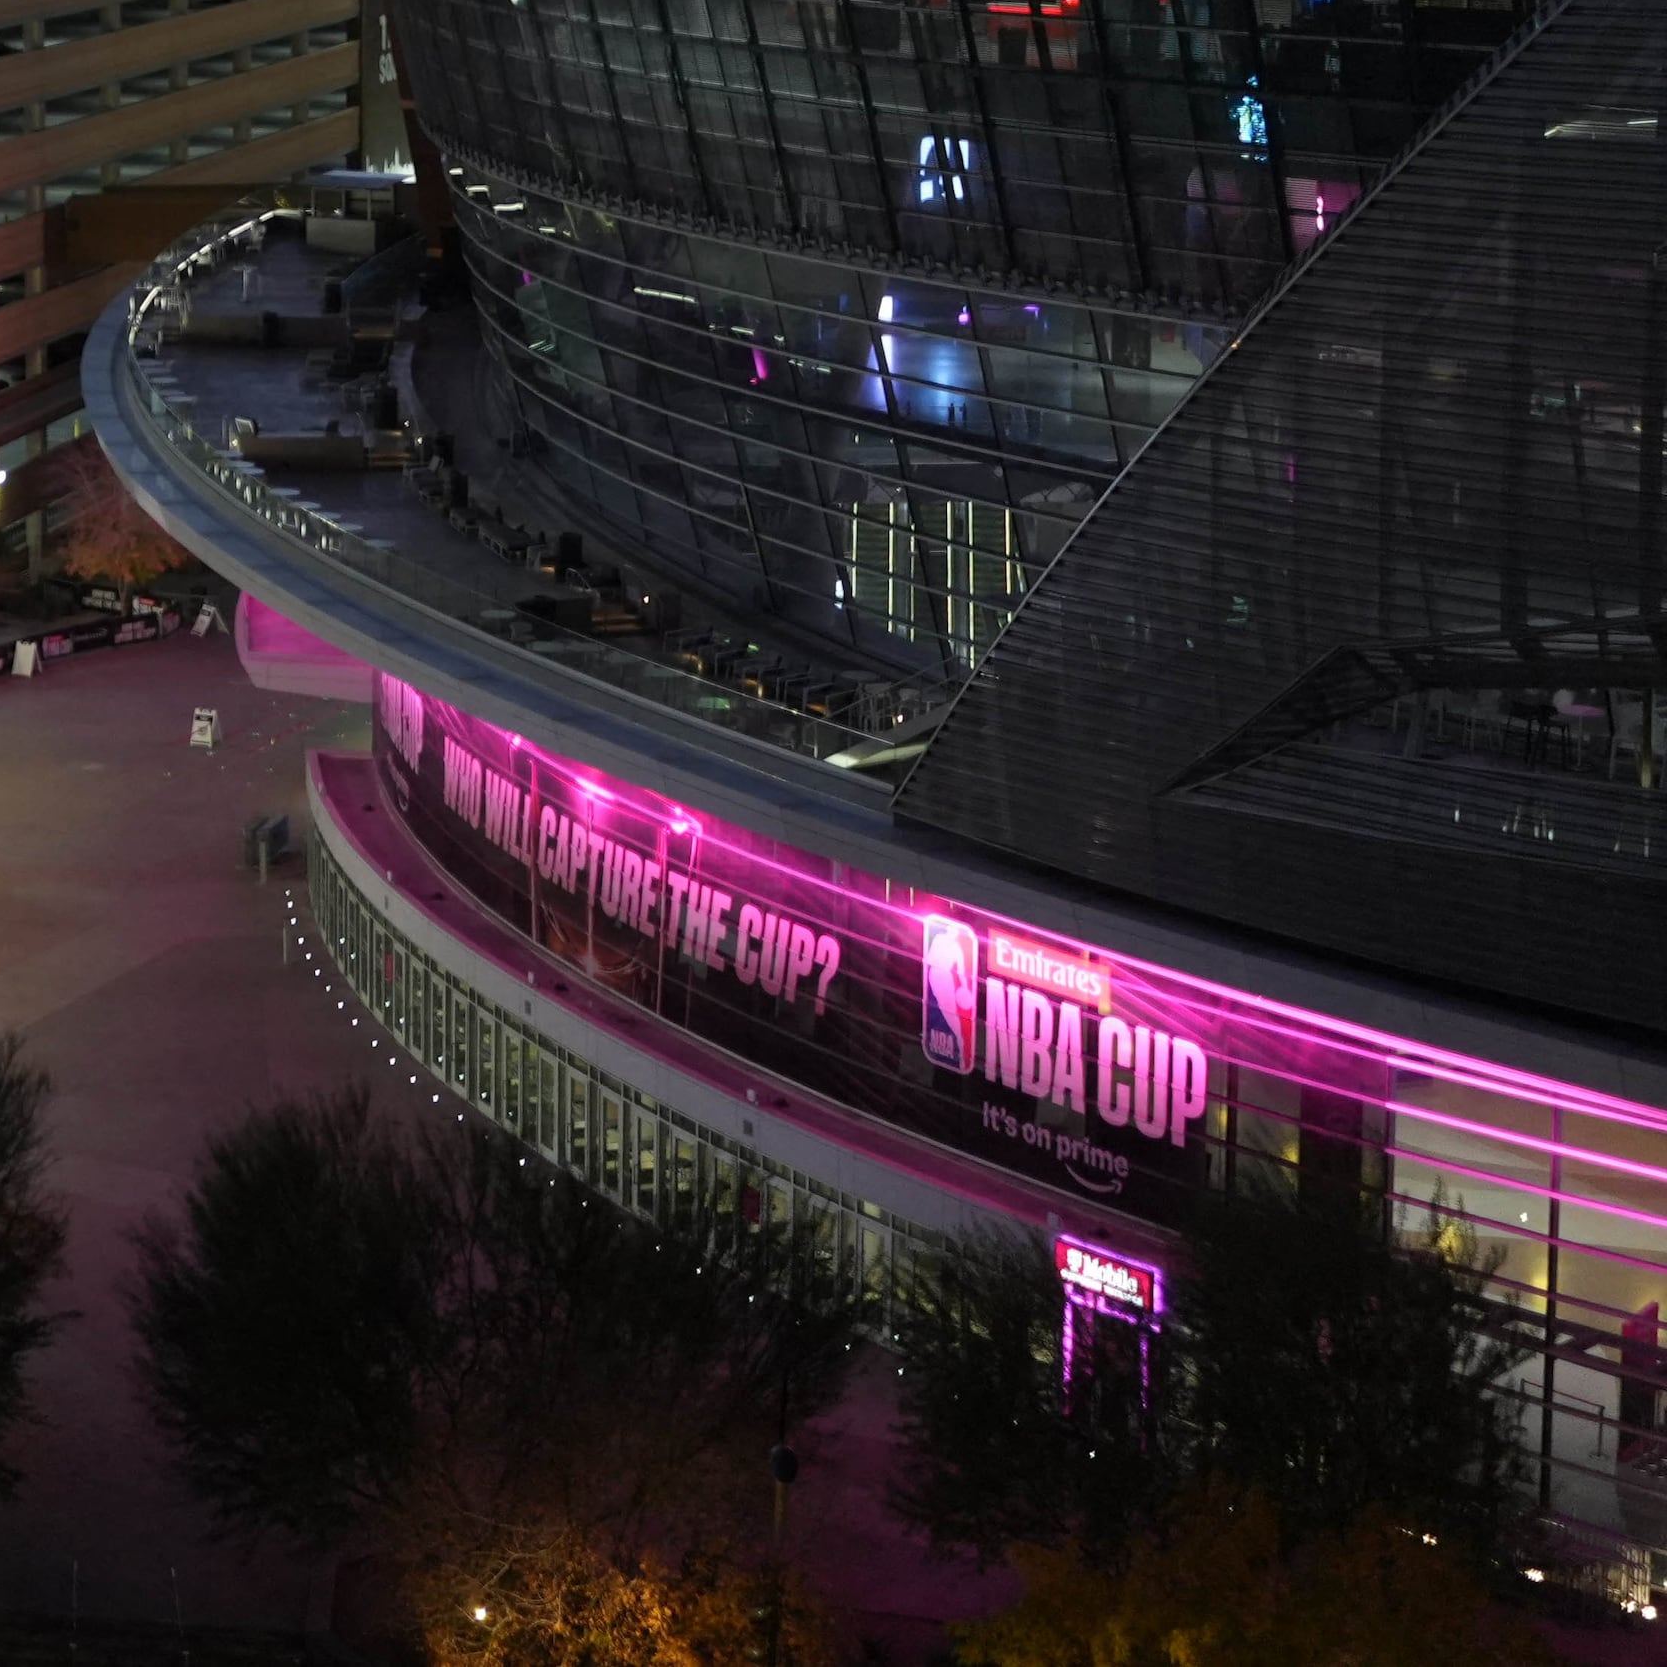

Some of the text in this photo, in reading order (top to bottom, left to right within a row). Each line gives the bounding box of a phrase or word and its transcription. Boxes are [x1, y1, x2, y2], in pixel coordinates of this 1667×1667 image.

[443, 734, 841, 1017] WHO WILL CAPTURE THE CUP?
[995, 936, 1103, 997] Emirates
[985, 977, 1208, 1149] NBA CUP
[982, 1100, 1130, 1178] It's on prime
